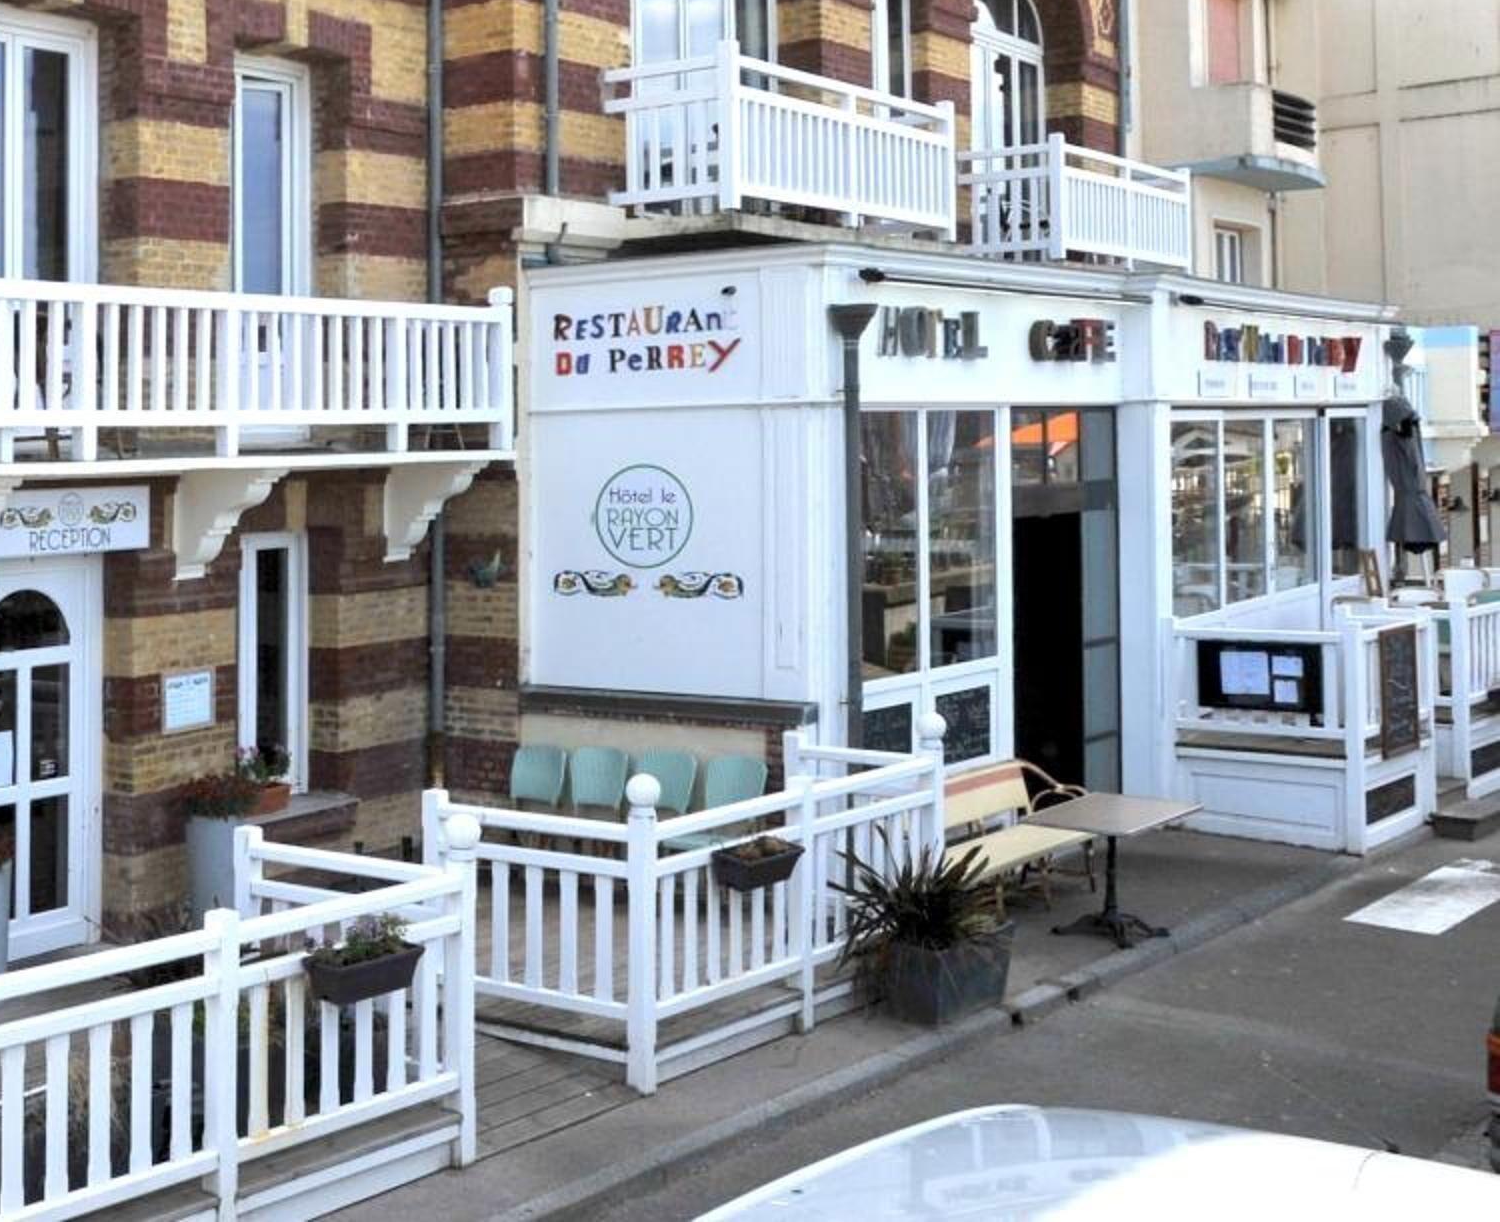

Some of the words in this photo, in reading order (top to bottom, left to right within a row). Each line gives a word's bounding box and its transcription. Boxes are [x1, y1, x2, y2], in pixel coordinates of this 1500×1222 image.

[661, 486, 677, 504] le
[607, 507, 679, 529] RAYON
[28, 527, 112, 552] RECEPTION
[607, 527, 678, 551] VERT
